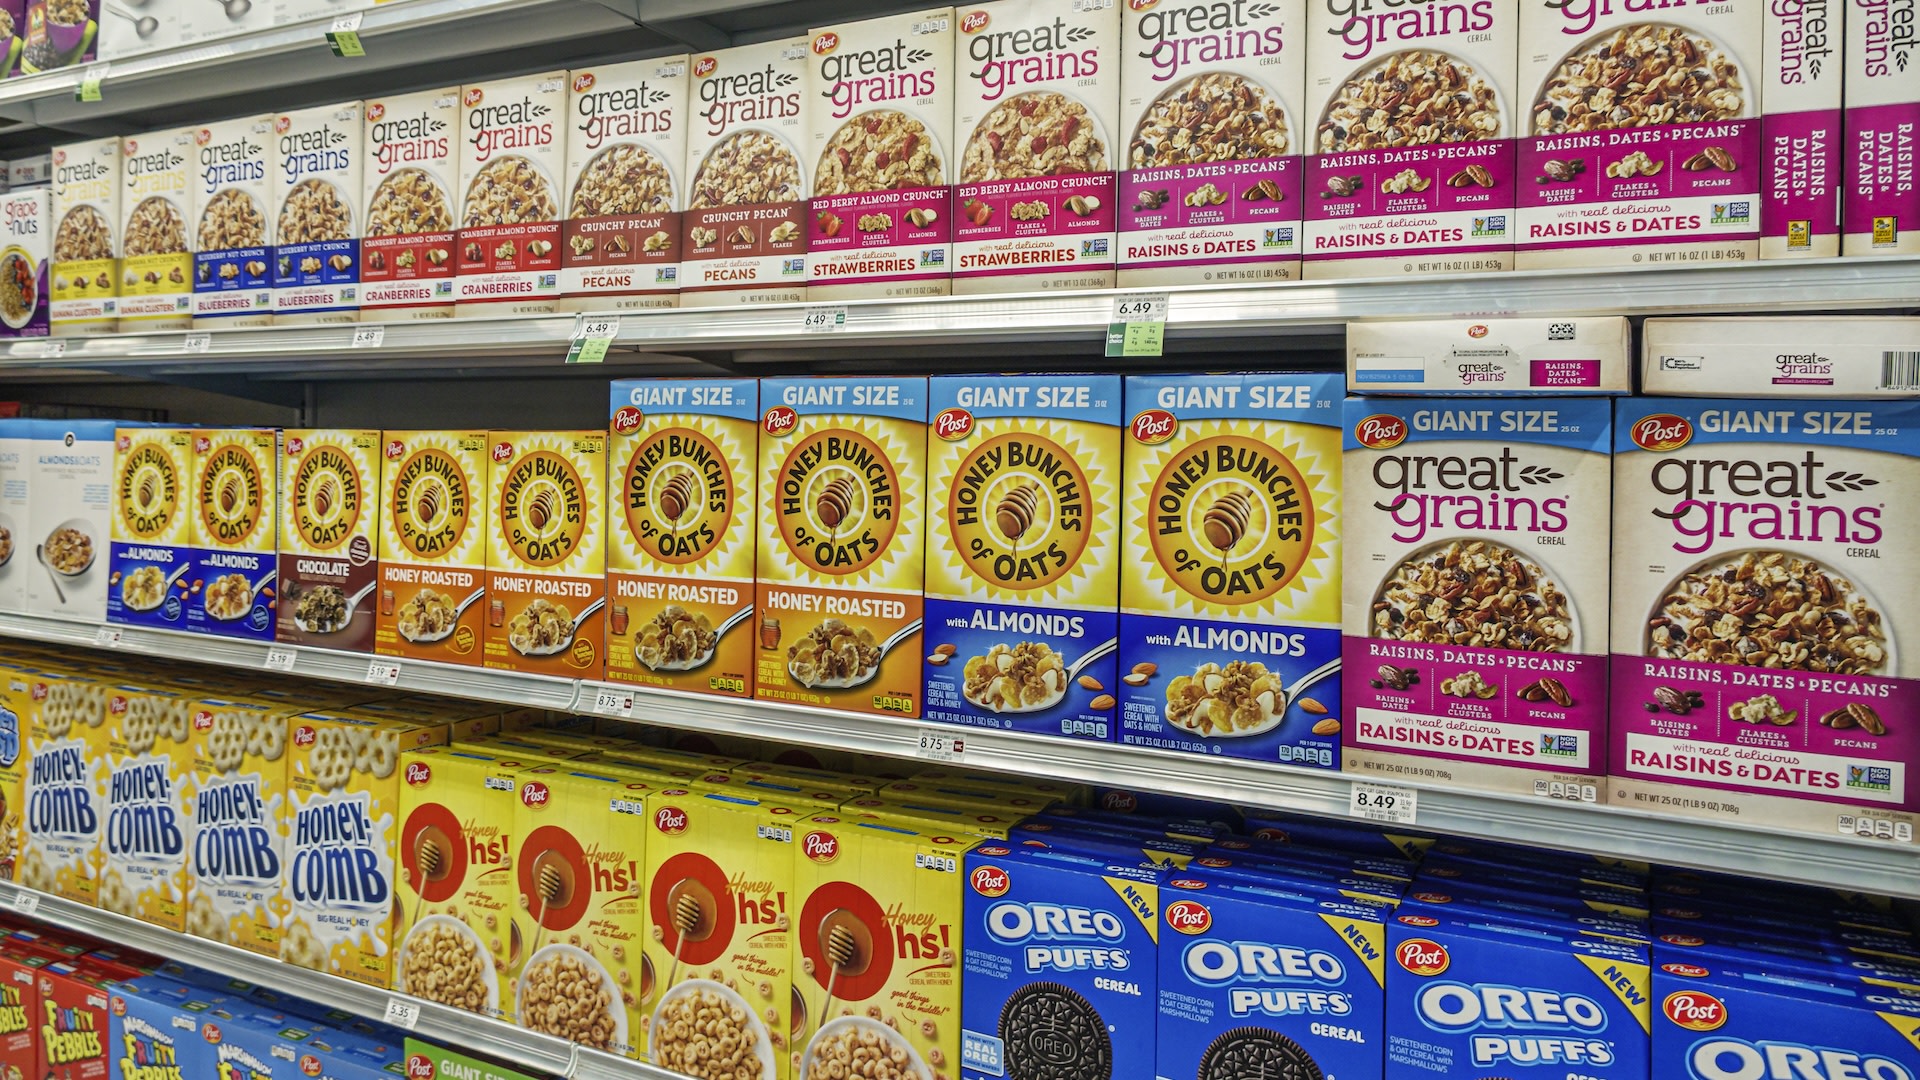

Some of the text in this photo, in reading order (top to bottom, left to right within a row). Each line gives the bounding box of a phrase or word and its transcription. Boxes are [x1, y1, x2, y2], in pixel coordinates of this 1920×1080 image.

[1705, 4, 1734, 16] CEREAL
[963, 14, 987, 31] Post
[815, 34, 836, 52] Post
[970, 16, 1066, 79] great
[1151, 25, 1283, 82] grains
[1259, 56, 1281, 66] CEREAL
[696, 58, 715, 73] Post
[821, 39, 905, 97] great
[981, 49, 1099, 100] grains
[700, 64, 773, 117] great
[1077, 78, 1097, 87] CEREAL
[579, 80, 647, 130] great
[707, 92, 800, 136] grains
[371, 112, 430, 156] great
[586, 108, 672, 149] grains
[1536, 136, 1605, 152] RAISINS,
[1610, 131, 1661, 145] DATES
[201, 136, 249, 179] great
[378, 136, 448, 174] grains
[1133, 169, 1184, 183] RAISINS,
[1187, 166, 1226, 178] DATES
[1809, 130, 1826, 201] RAISINS,
[205, 159, 264, 194] grains
[1692, 179, 1731, 187] PECANS
[960, 188, 978, 198] RED
[980, 184, 1012, 196] BERRY
[1014, 180, 1058, 193] ALMOND
[1612, 189, 1659, 198] CLUSTERS
[1614, 183, 1649, 191] FLAKES
[5, 200, 38, 220] grape
[1557, 204, 1671, 218] with real delicious
[580, 221, 626, 232] CRUNCHY
[1530, 215, 1701, 237] RAISINS & DATES
[364, 238, 396, 248] CRANBERRY
[398, 236, 424, 245] ALMOND
[1128, 240, 1256, 259] RAISINS & DATES
[960, 248, 1076, 268] STRAWBERRIES
[1649, 250, 1745, 262] NET WT 16 OZ (1 LB) 453g
[704, 269, 756, 282] PECANS
[814, 258, 916, 276] STRAWBERRIES
[462, 282, 532, 296] CRANBERRIES
[582, 276, 631, 288] PECANS
[198, 298, 250, 311] BLUEBERRIES
[366, 288, 431, 302] CRANBERRIES
[1119, 303, 1151, 314] 6.49
[356, 332, 375, 342] 6.49
[586, 323, 608, 334] 6.49
[1458, 361, 1493, 374] great
[1459, 371, 1504, 385] grains
[630, 388, 732, 406] GIANT SIZE
[783, 386, 900, 406] GIANT SIZE
[957, 387, 1090, 408] GIANT SIZE
[1158, 386, 1311, 409] GIANT SIZE
[615, 410, 640, 428] Post
[937, 412, 969, 431] Post
[1413, 412, 1558, 433] GIANT SIZE
[1360, 420, 1403, 443] Post
[957, 442, 1082, 532] HONEY BUNCHES
[1373, 447, 1520, 511] great
[1651, 450, 1824, 519] great
[1391, 492, 1568, 545] grains
[1672, 499, 1883, 554] grains
[1537, 535, 1566, 546] CEREAL
[210, 554, 259, 570] ALMONDS
[297, 560, 349, 577] CHOCOLATE
[971, 538, 1067, 582] of OATS
[385, 568, 473, 587] HONEY ROASTED
[617, 580, 738, 605] HONEY ROASTED
[947, 609, 1084, 638] with ALMONDS
[1174, 625, 1306, 656] ALMONDS
[270, 654, 287, 663] 5.19
[1124, 702, 1156, 714] SWEETENED
[1124, 711, 1159, 723] CEREAL WITH
[1124, 720, 1163, 732] OATS & HONEY
[1357, 792, 1395, 809] 8.49
[807, 834, 835, 854] Post
[977, 870, 1005, 888] Post
[1123, 885, 1154, 919] NEW
[881, 902, 936, 934] Honey
[989, 905, 1121, 939] OREO
[1344, 925, 1379, 961] NEW
[1028, 948, 1127, 969] PUFFS
[1187, 943, 1342, 981] OREO
[1094, 977, 1142, 996] CEREAL
[891, 989, 930, 1004] good things
[1160, 990, 1214, 1008] SWEETENED CORN
[1232, 991, 1349, 1013] PUFFS
[1421, 985, 1603, 1027] OREO
[391, 1006, 409, 1018] 5.35
[1160, 1007, 1209, 1023] MARSHMALLOWS
[1165, 1000, 1180, 1009] OAT
[1180, 1002, 1199, 1013] CEREAL
[1200, 1008, 1214, 1017] with
[1673, 996, 1718, 1020] Post
[964, 1049, 998, 1065] OREO
[965, 1040, 997, 1056] REAL
[1475, 1037, 1611, 1062] PUFFS
